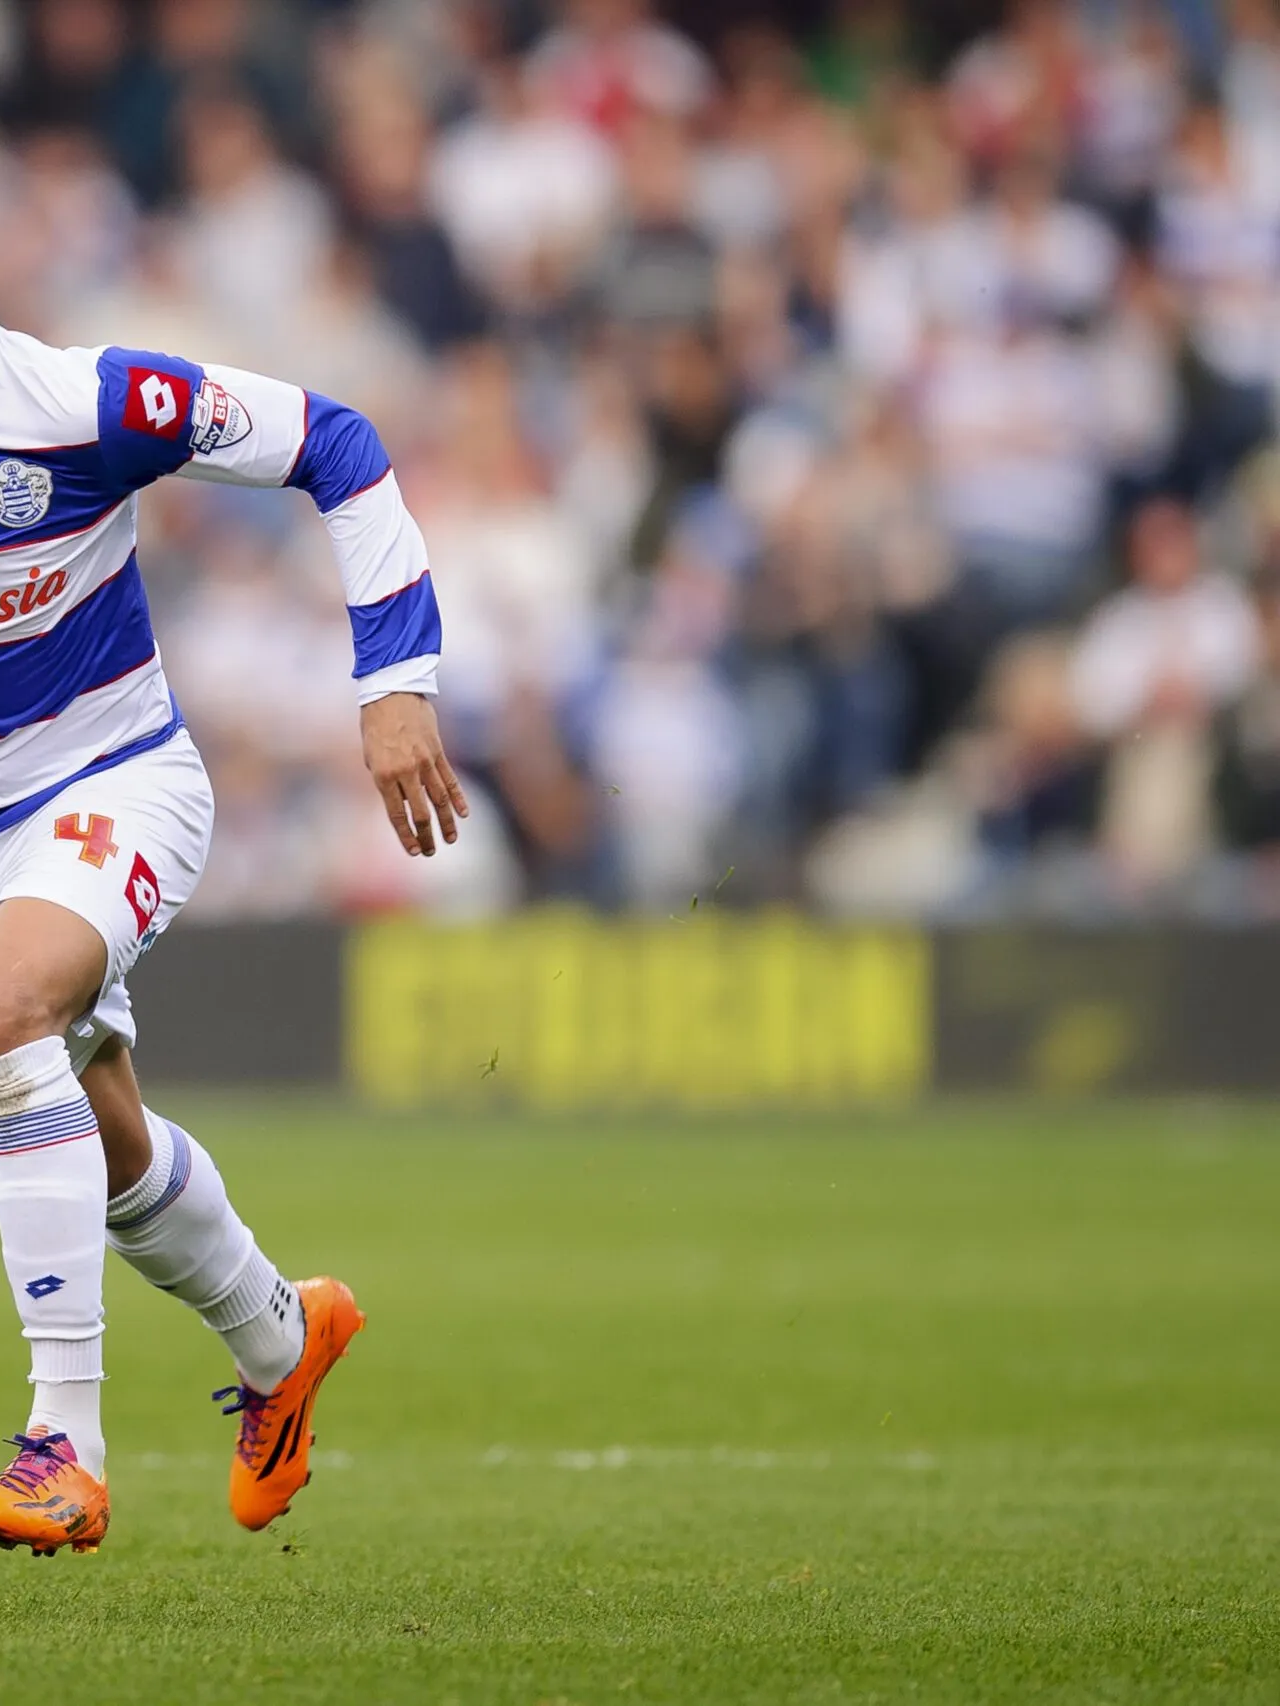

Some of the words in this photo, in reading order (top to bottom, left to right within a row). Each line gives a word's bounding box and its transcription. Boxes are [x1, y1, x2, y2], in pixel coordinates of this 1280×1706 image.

[200, 424, 222, 452] sky
[213, 385, 226, 420] BET
[54, 812, 120, 870] 4
